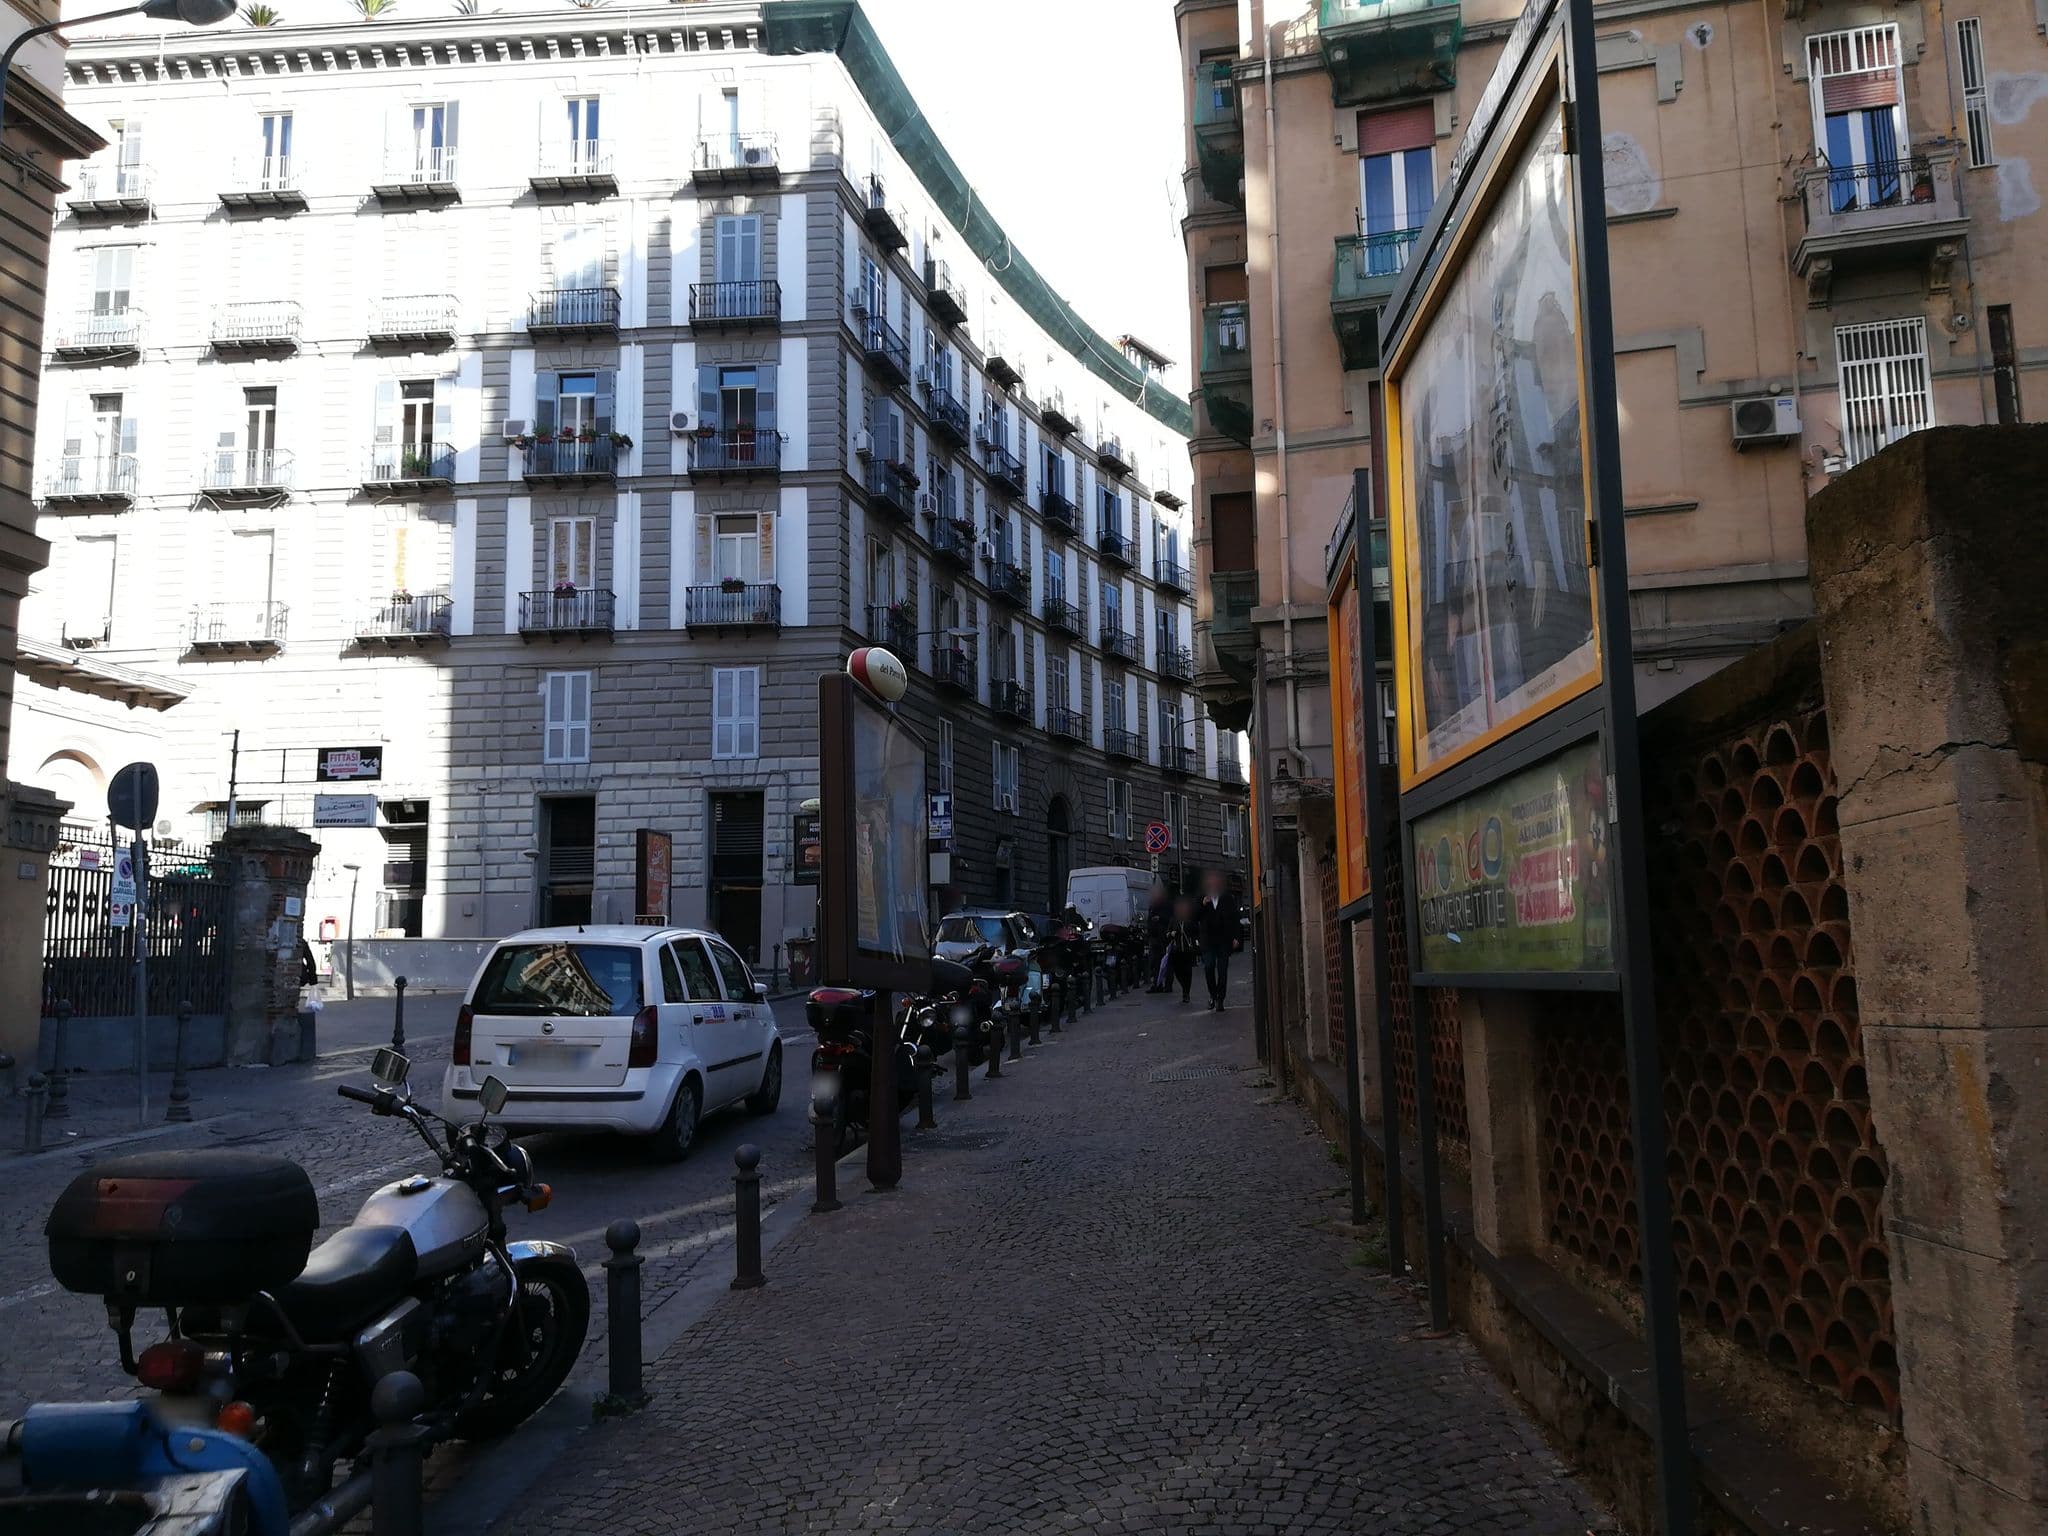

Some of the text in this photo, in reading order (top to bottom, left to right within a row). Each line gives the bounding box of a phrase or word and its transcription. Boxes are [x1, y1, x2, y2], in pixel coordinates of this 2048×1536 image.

[330, 753, 358, 762] FITTASI
[1418, 810, 1504, 897] mondo
[635, 917, 663, 926] TAXI
[1422, 887, 1506, 934] CAMERETTE
